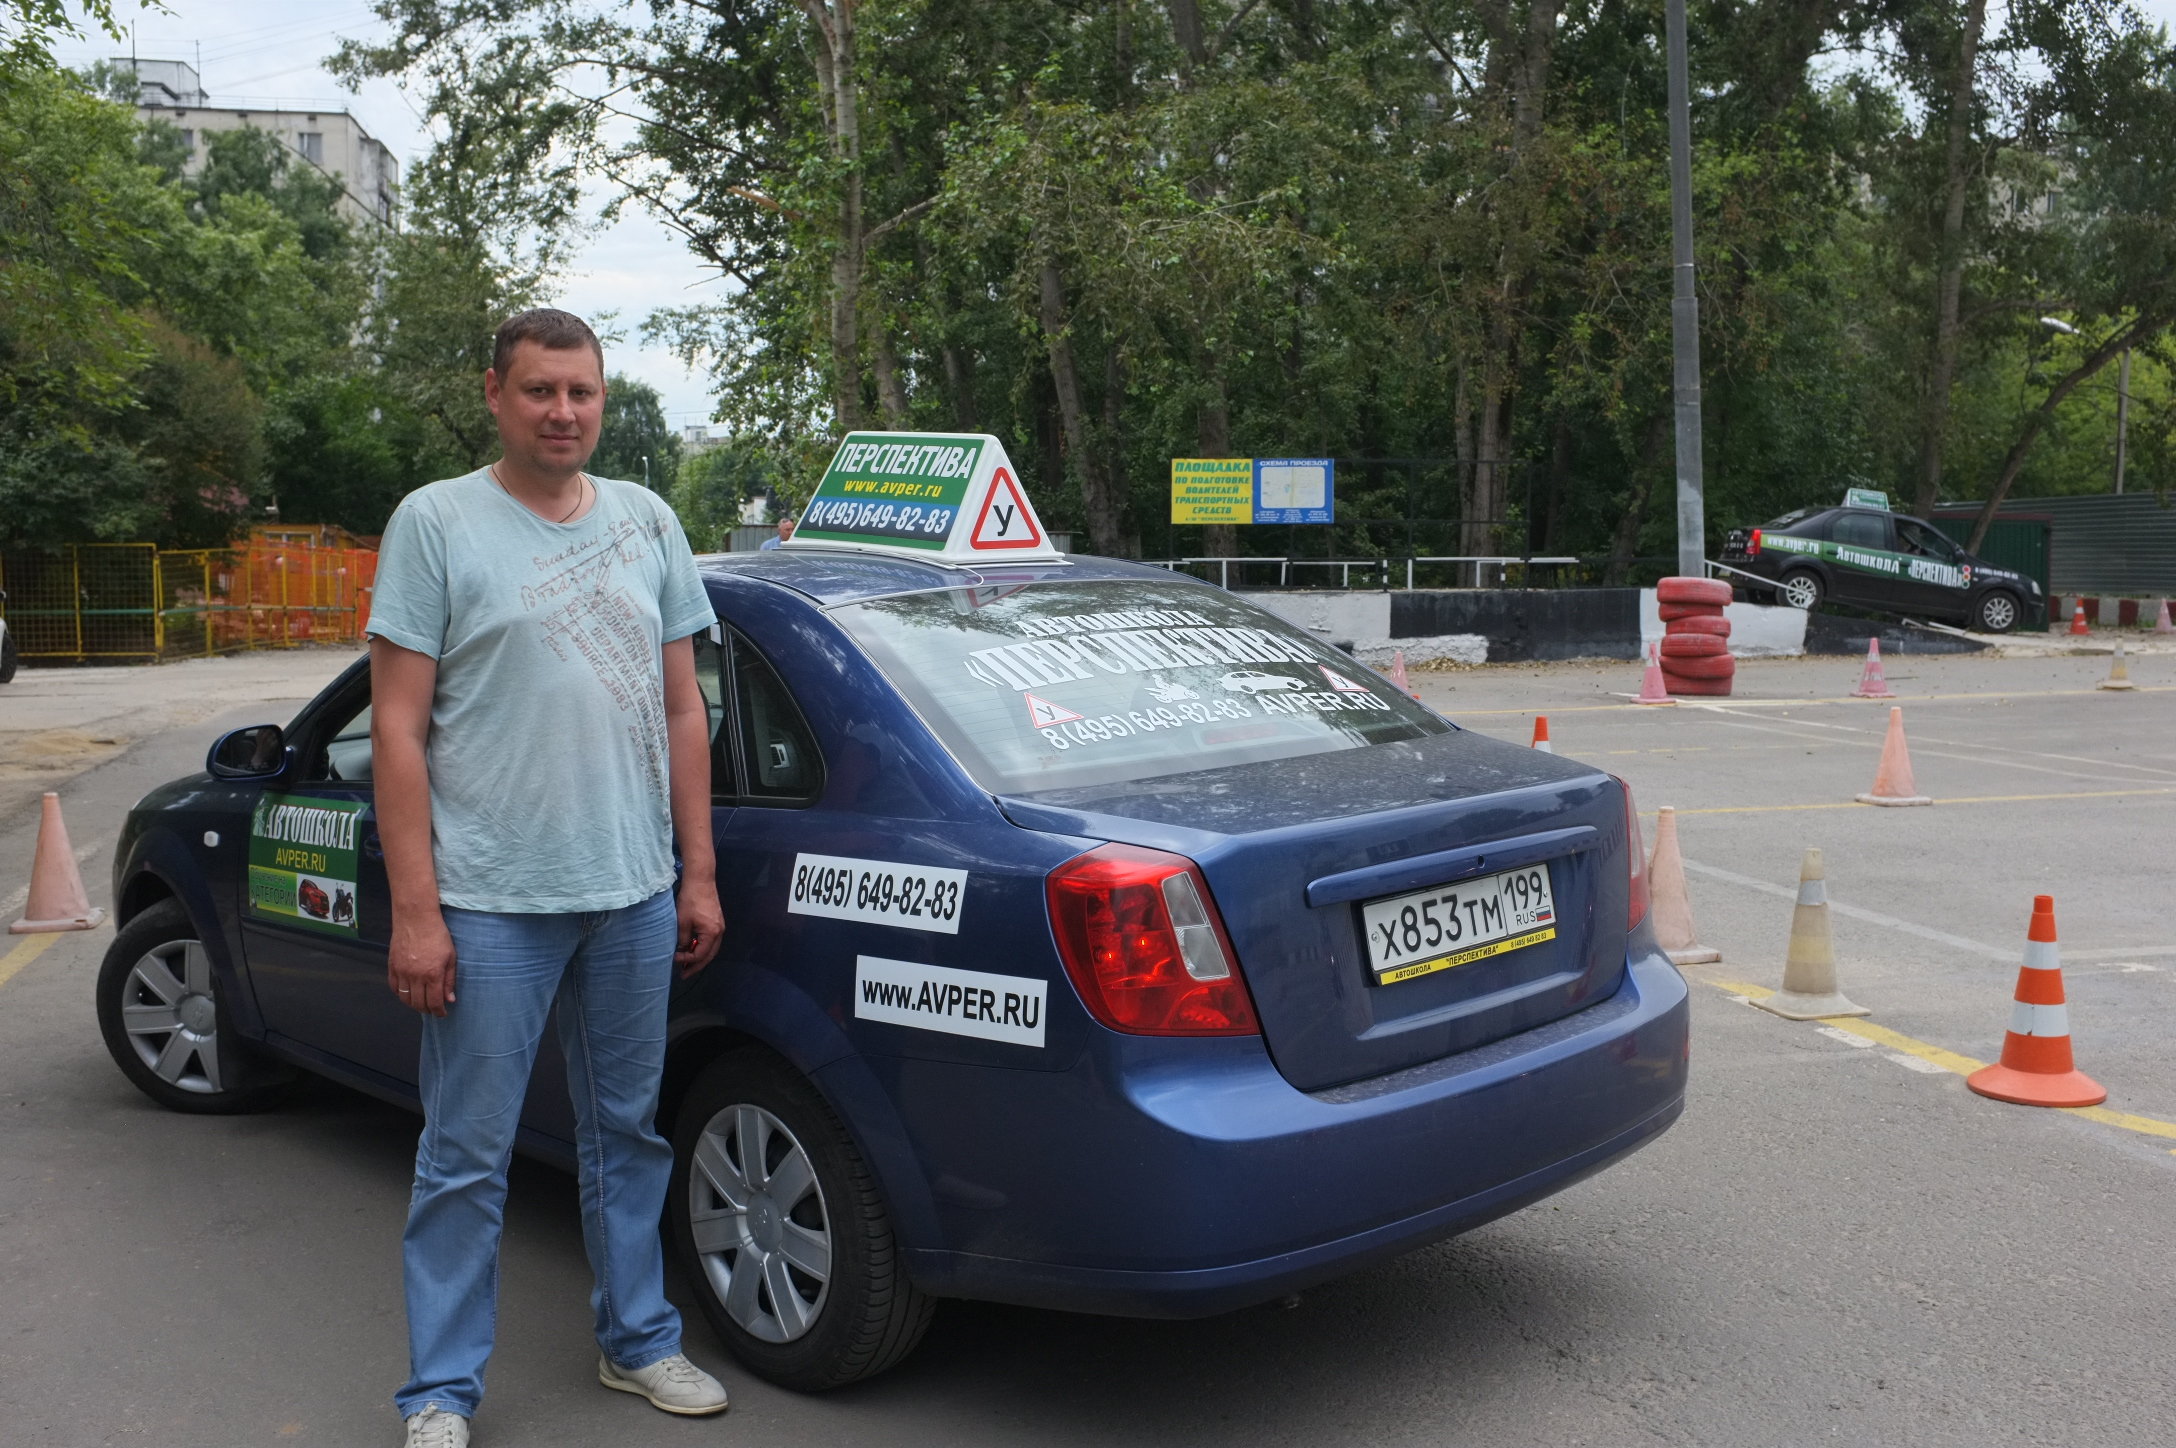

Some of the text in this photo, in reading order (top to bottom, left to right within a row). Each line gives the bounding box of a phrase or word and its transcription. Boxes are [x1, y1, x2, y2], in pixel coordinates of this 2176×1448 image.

[835, 443, 977, 479] ПЕРСПЕКТИВА
[1175, 462, 1250, 473] ПЛОЩАДКА
[843, 479, 943, 498] www.avper.ru
[1175, 476, 1250, 484] ПО ПОДГОТОВКЕ
[1185, 485, 1239, 494] ВОДИТЕЛЕЙ
[809, 501, 950, 534] 8(495)649-82-83
[1192, 506, 1232, 514] СРЕДСТВ
[1767, 536, 1820, 555] www.avper.ru
[612, 595, 635, 621] NEW
[1014, 609, 1216, 639] АВТОШКОЛА
[591, 626, 642, 696] DEPARTMENT
[1132, 698, 1252, 732] 649-82-83
[1256, 692, 1391, 716] AVPER.RU
[264, 804, 361, 850] АВТОШКОЛА
[275, 847, 326, 873] AVPER.RU
[794, 864, 959, 921] 8(495) 649-82-83
[1504, 871, 1544, 911] 199
[1516, 912, 1536, 926] RUS
[1394, 964, 1432, 980] АВТОШКОЛА
[1446, 944, 1499, 966] "ПЕРСПЕКТИВА"
